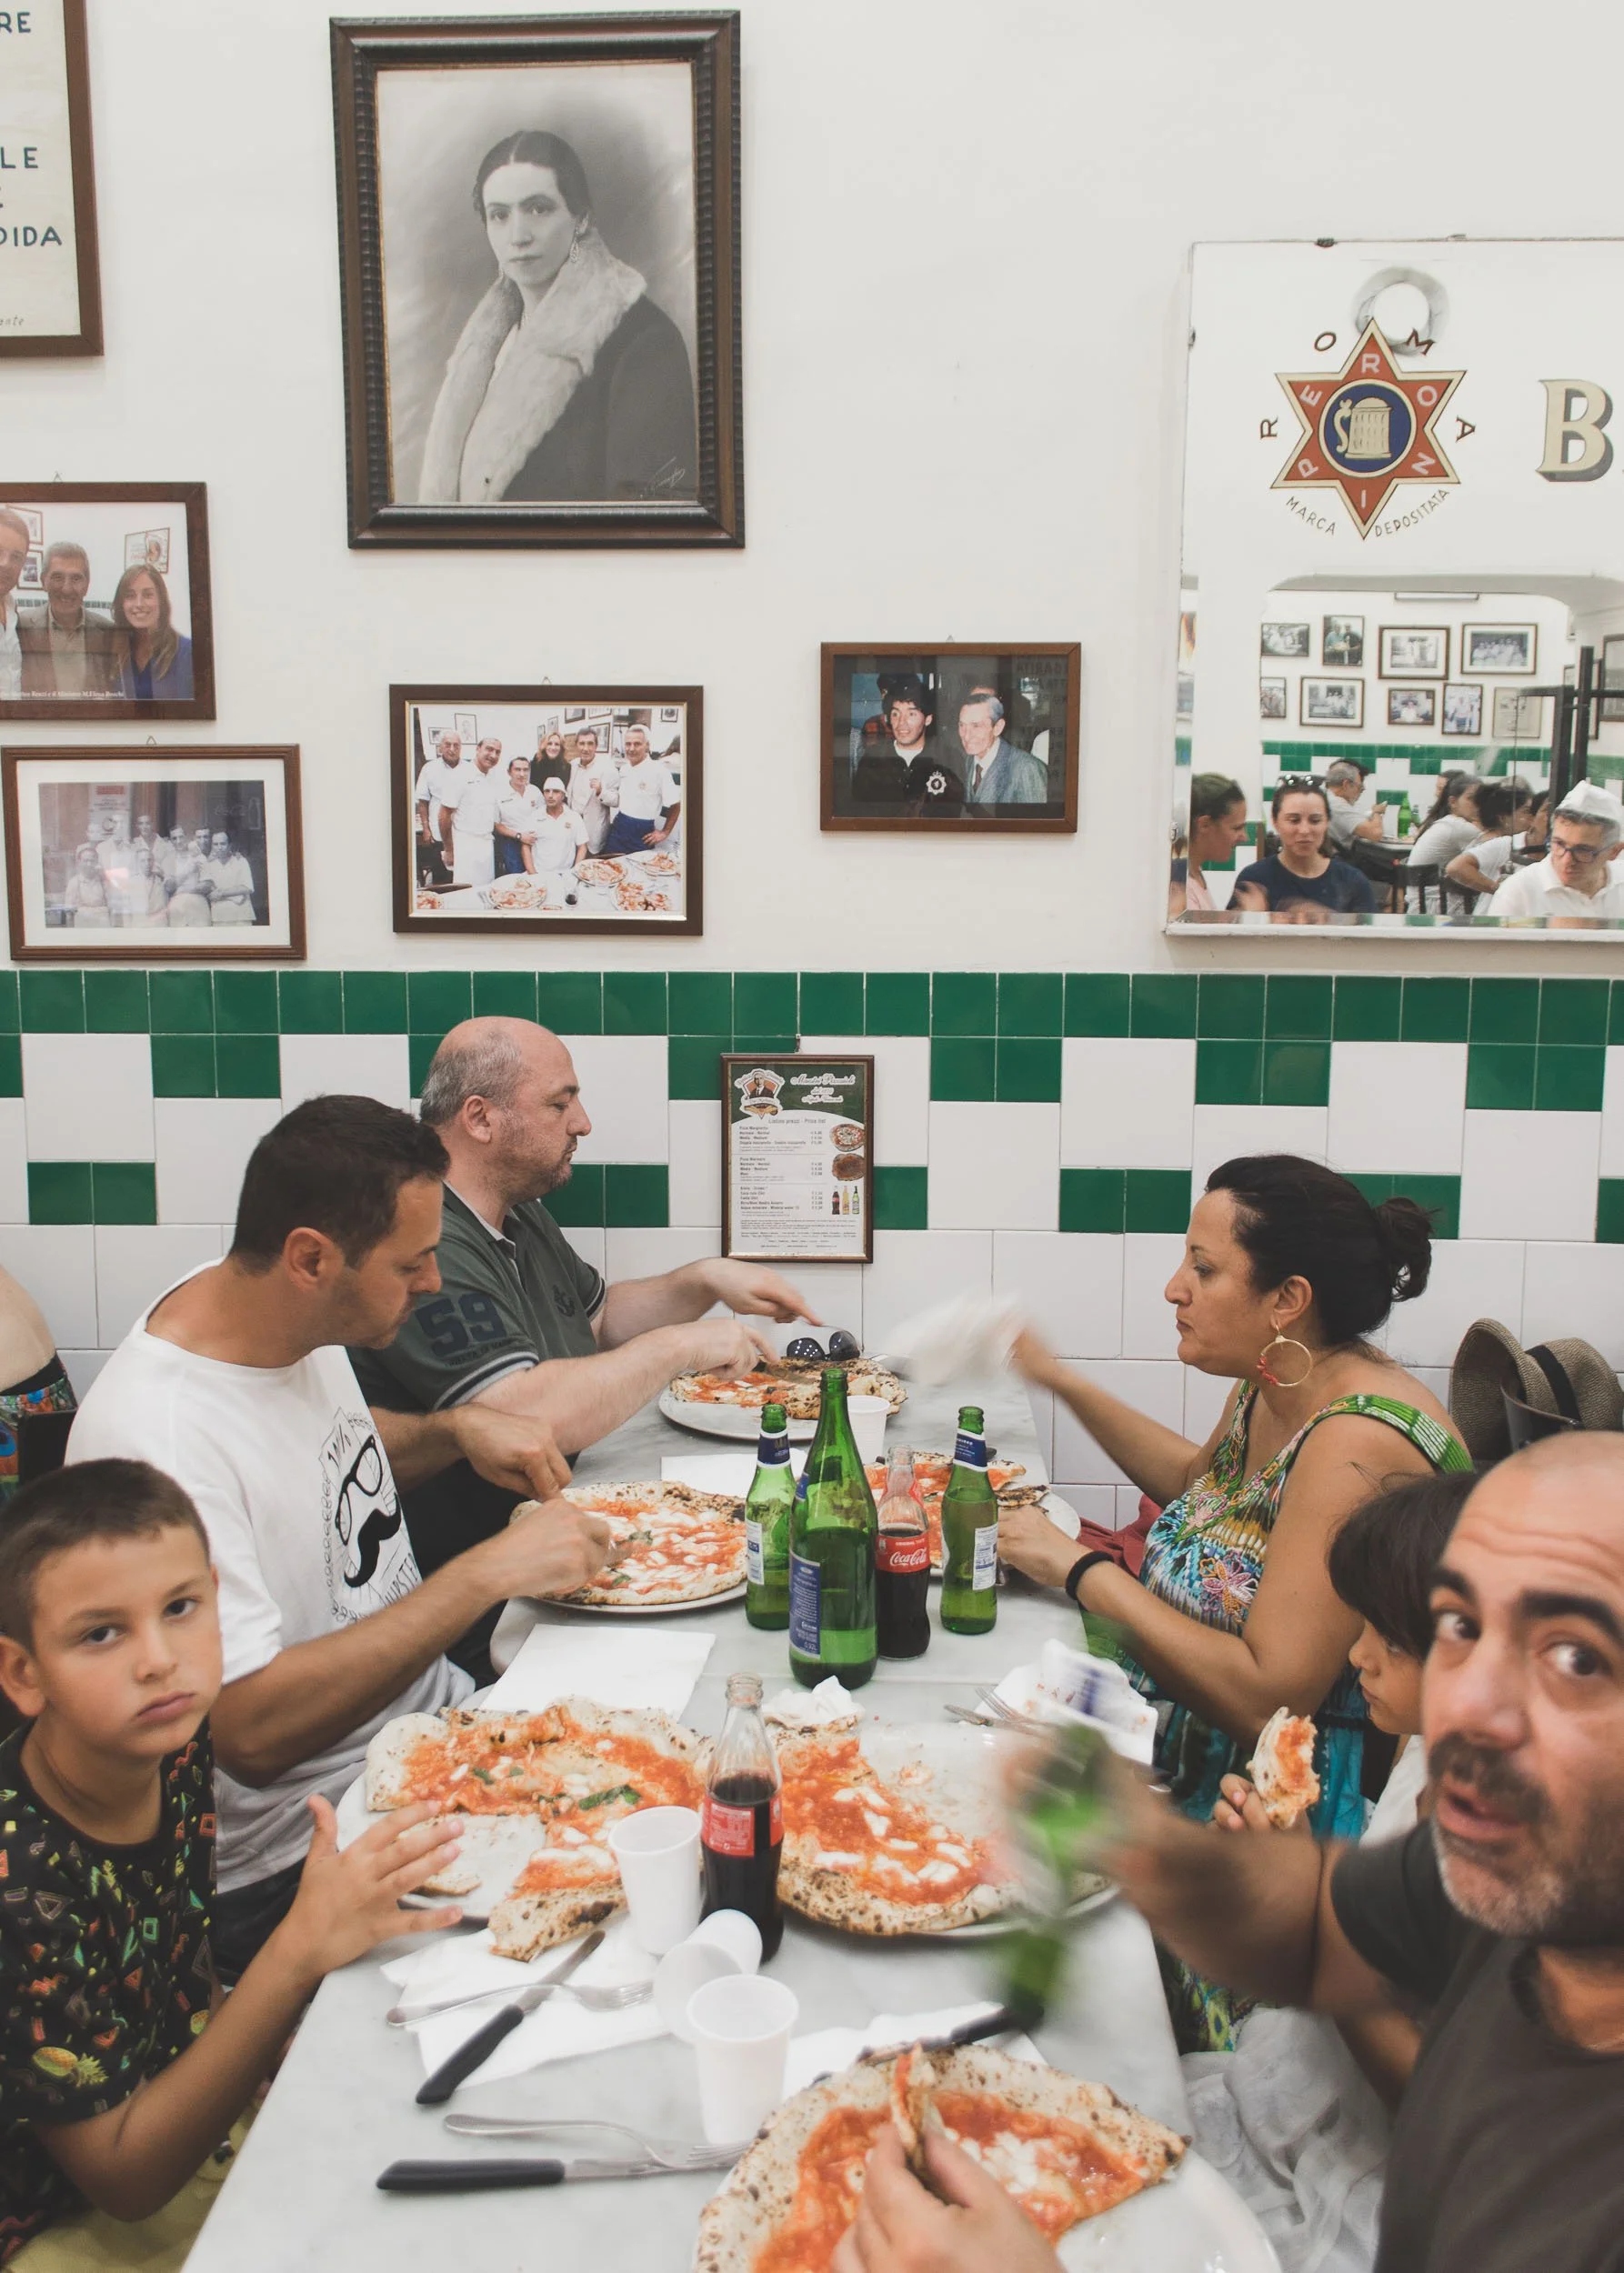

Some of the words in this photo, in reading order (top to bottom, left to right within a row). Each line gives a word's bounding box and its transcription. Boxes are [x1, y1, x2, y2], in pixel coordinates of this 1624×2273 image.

[0, 146, 39, 169] LE
[1260, 328, 1477, 443] ROMA
[1298, 351, 1439, 509] PERONI
[1285, 496, 1337, 536] MARCA
[1374, 487, 1452, 538] DEPOSITATA
[415, 1293, 507, 1357] 59
[889, 1547, 927, 1567] Coca-Cola
